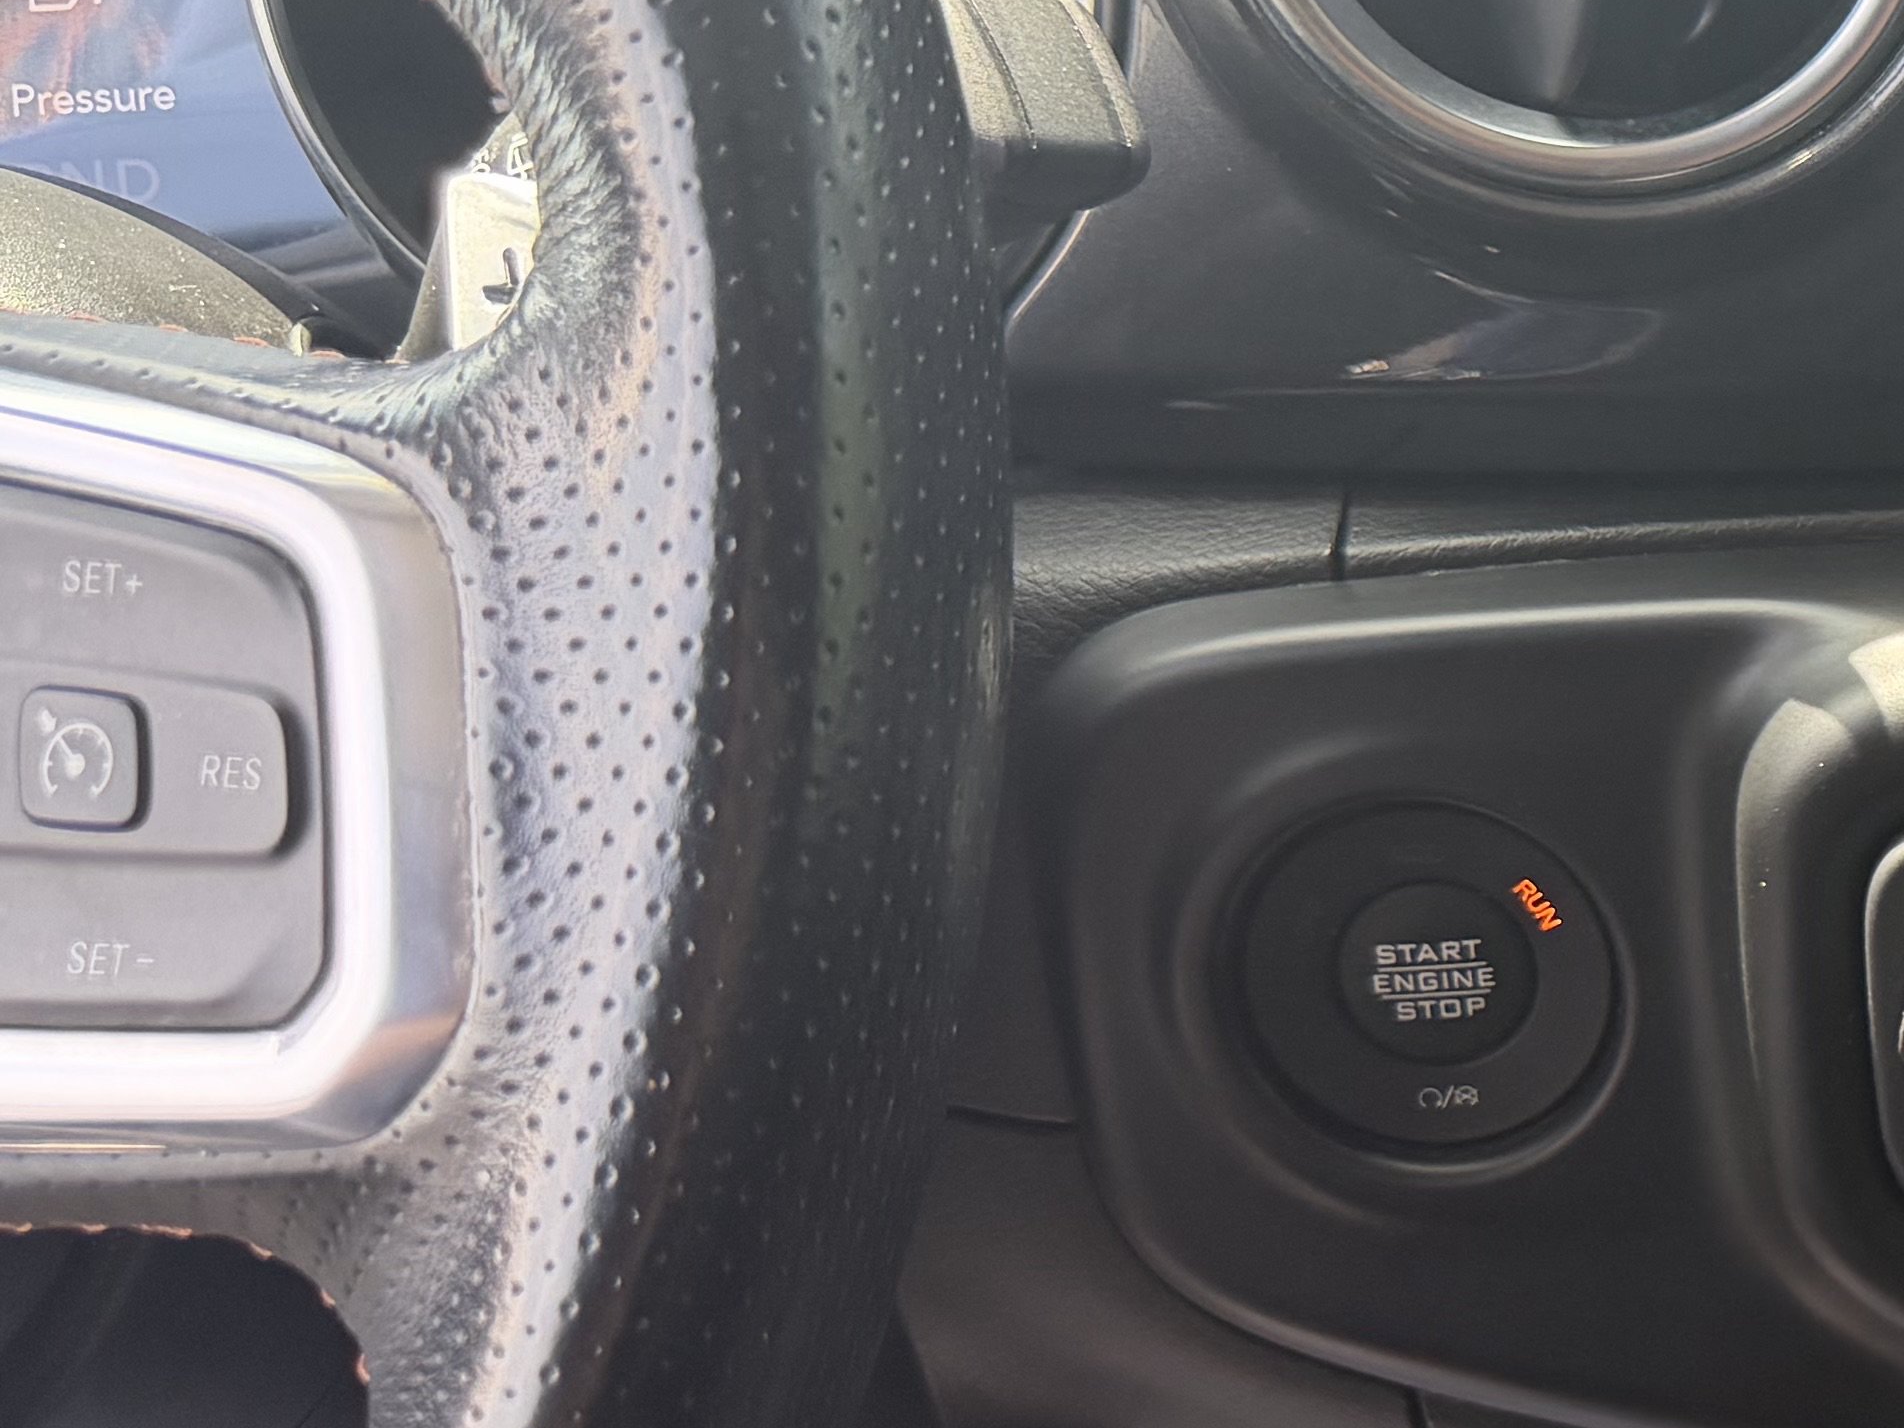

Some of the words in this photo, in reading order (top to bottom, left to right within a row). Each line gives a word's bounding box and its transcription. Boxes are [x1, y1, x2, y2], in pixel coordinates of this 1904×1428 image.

[11, 83, 176, 117] Pressure
[200, 754, 262, 790] RES
[1511, 878, 1563, 932] RUN
[1376, 939, 1482, 965] START
[1373, 968, 1496, 993] ENGINE
[1397, 996, 1486, 1021] STOP
